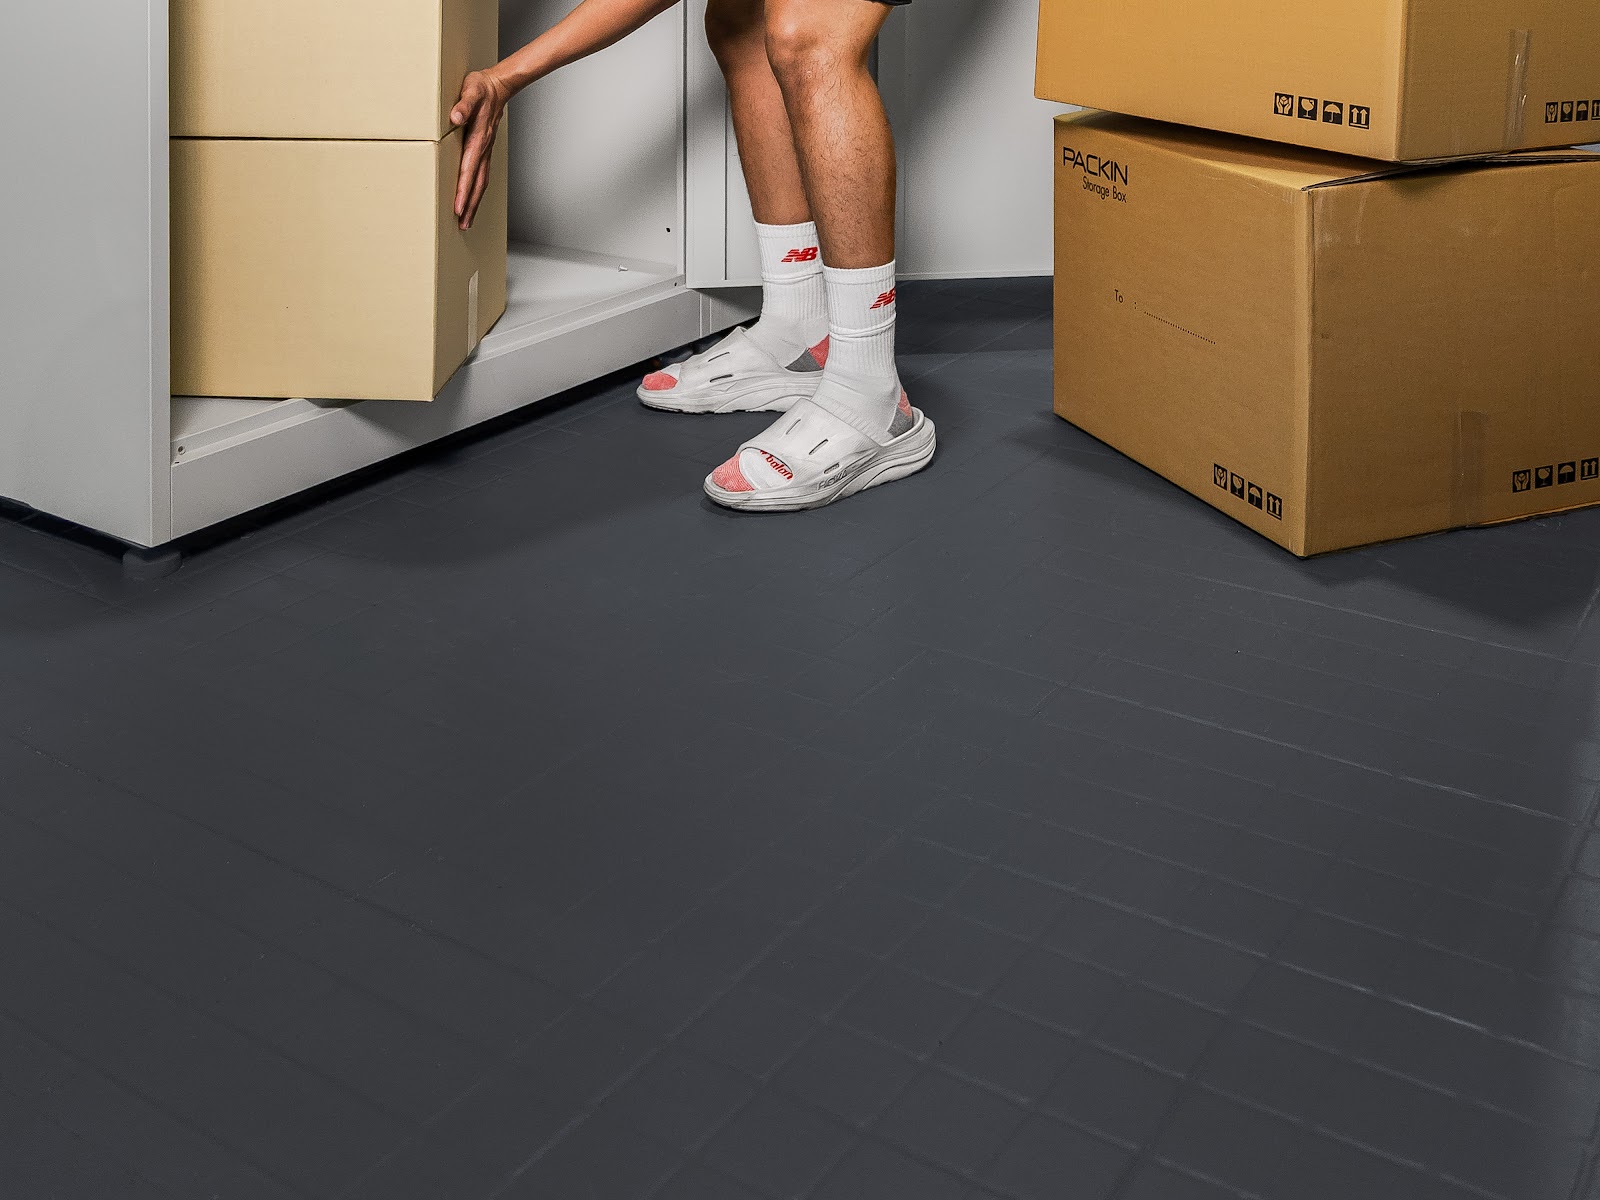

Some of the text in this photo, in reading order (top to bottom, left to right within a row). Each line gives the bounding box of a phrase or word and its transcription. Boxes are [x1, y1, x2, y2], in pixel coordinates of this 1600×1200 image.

[1062, 146, 1129, 186] PACKIN
[1082, 176, 1127, 203] Storage Box
[781, 246, 819, 263] NB
[1114, 288, 1124, 303] To
[765, 454, 793, 480] balan
